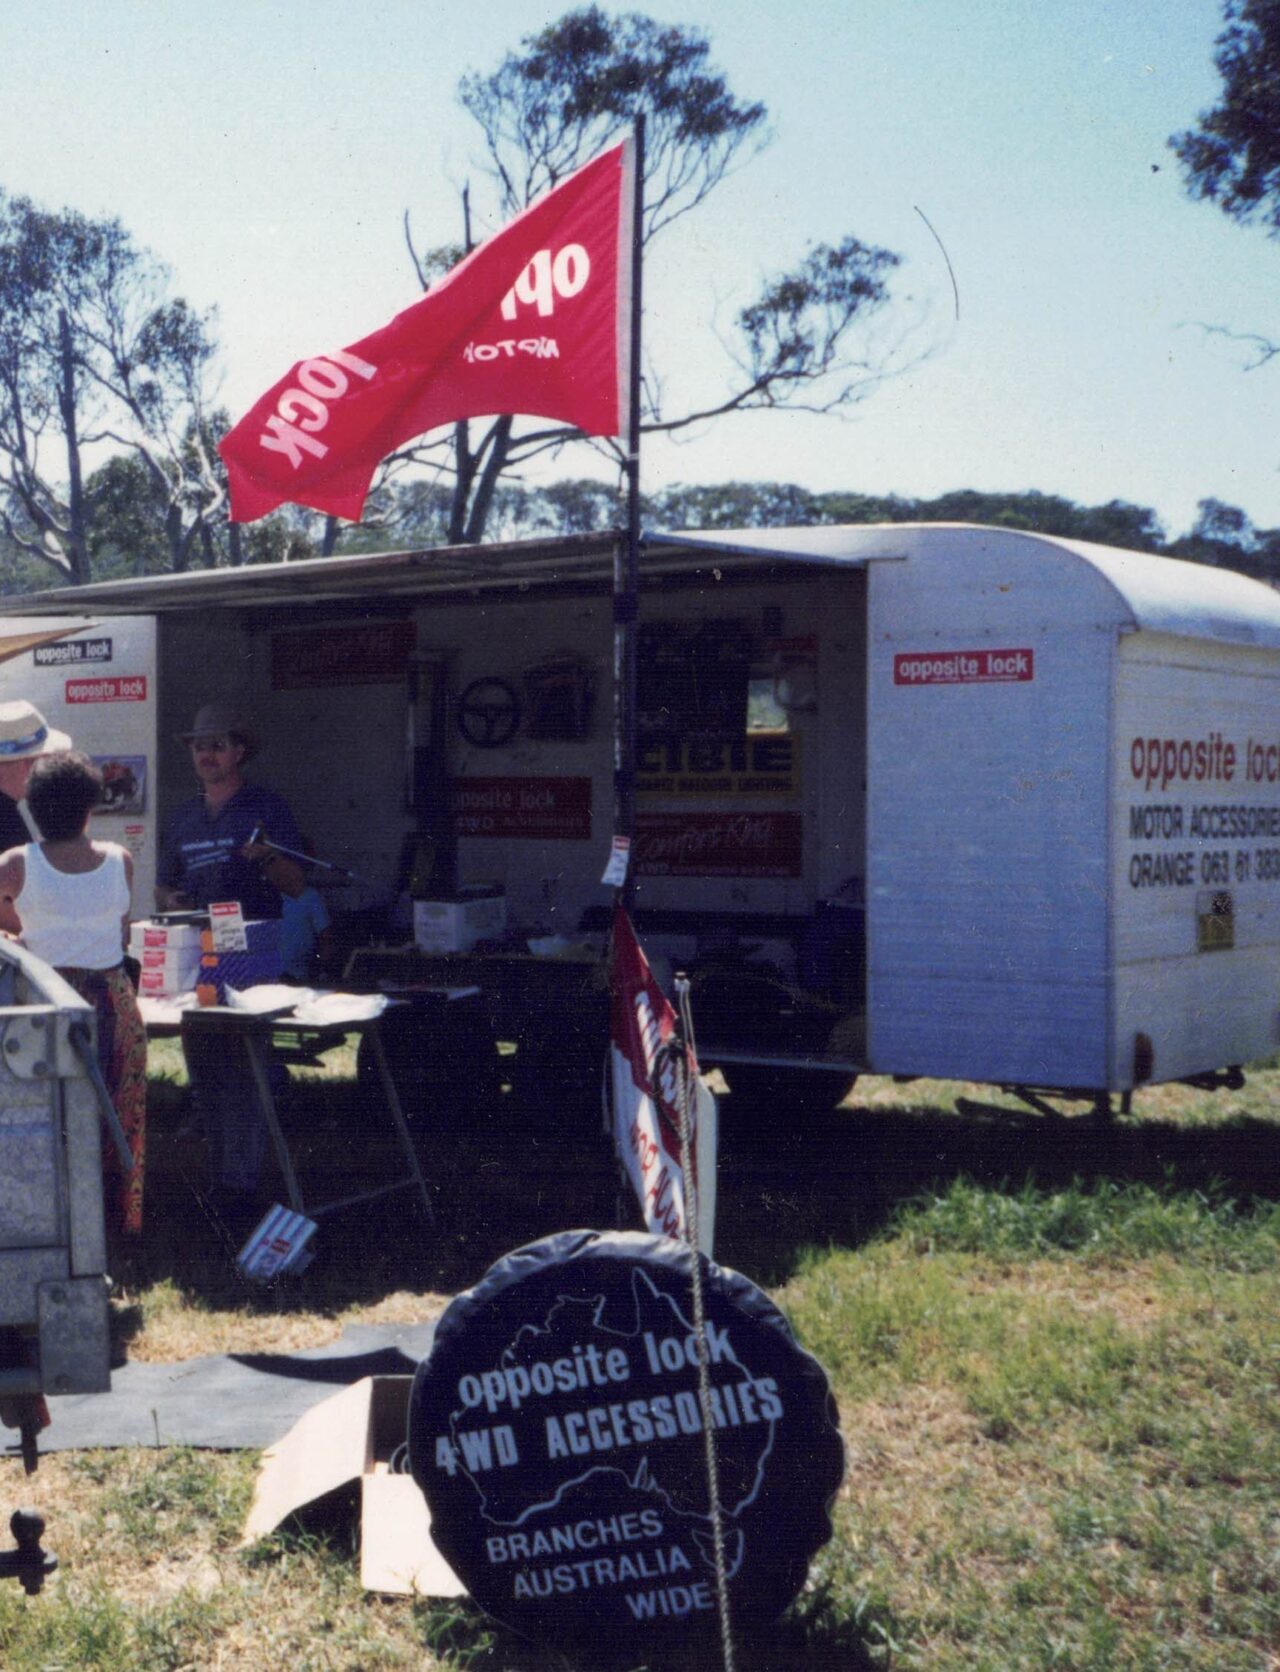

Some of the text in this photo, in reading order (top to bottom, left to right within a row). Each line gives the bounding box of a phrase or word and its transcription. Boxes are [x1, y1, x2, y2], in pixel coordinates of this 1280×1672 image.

[35, 640, 111, 663] opposite lock
[898, 652, 1028, 681] opposite lock
[67, 678, 144, 702] opposite lock
[1130, 732, 1280, 791] opposite loc
[1129, 804, 1183, 840] MOTOR
[1128, 851, 1195, 889] ORANGE
[458, 1321, 736, 1414] opposite lock
[435, 1377, 784, 1477] 4WD ACCESSORIES
[486, 1509, 664, 1563] BRANCHES
[513, 1546, 692, 1599] AUSTRALIA
[626, 1583, 715, 1621] WIDE
